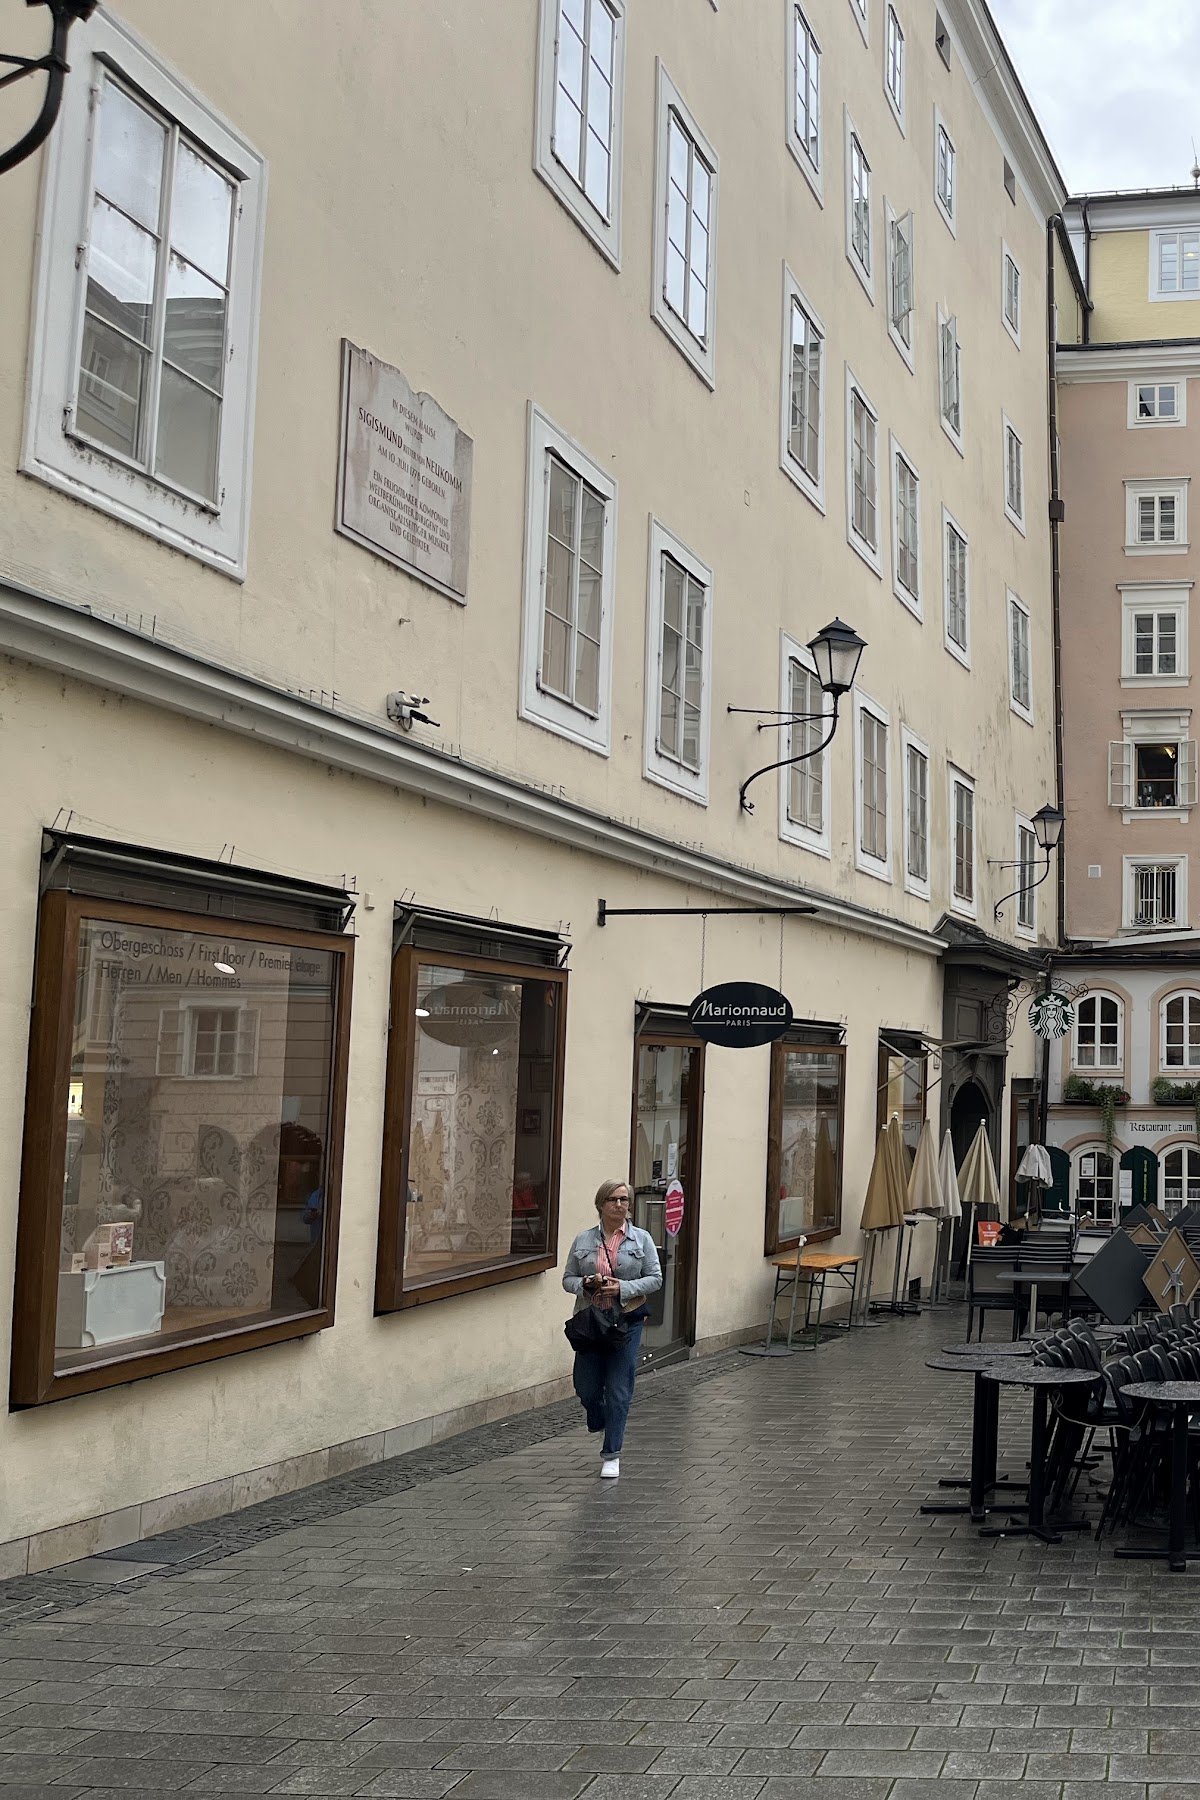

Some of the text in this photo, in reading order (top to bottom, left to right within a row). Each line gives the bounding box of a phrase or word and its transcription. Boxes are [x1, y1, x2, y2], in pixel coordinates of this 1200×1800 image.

[399, 404, 419, 424] DIESEM
[405, 422, 423, 444] WURDE
[358, 407, 403, 448] SIGISMUND
[426, 456, 462, 493] NEUKOMM
[378, 445, 388, 459] AM
[374, 470, 383, 484] EIN
[389, 521, 402, 536] UND
[101, 931, 184, 958] Obergeschoss
[222, 949, 246, 966] floor
[101, 963, 141, 981] Herren
[157, 966, 182, 984] Men
[197, 970, 241, 989] Hommes
[692, 1000, 786, 1020] Marionnaud
[1129, 1122, 1170, 1132] Restaurant
